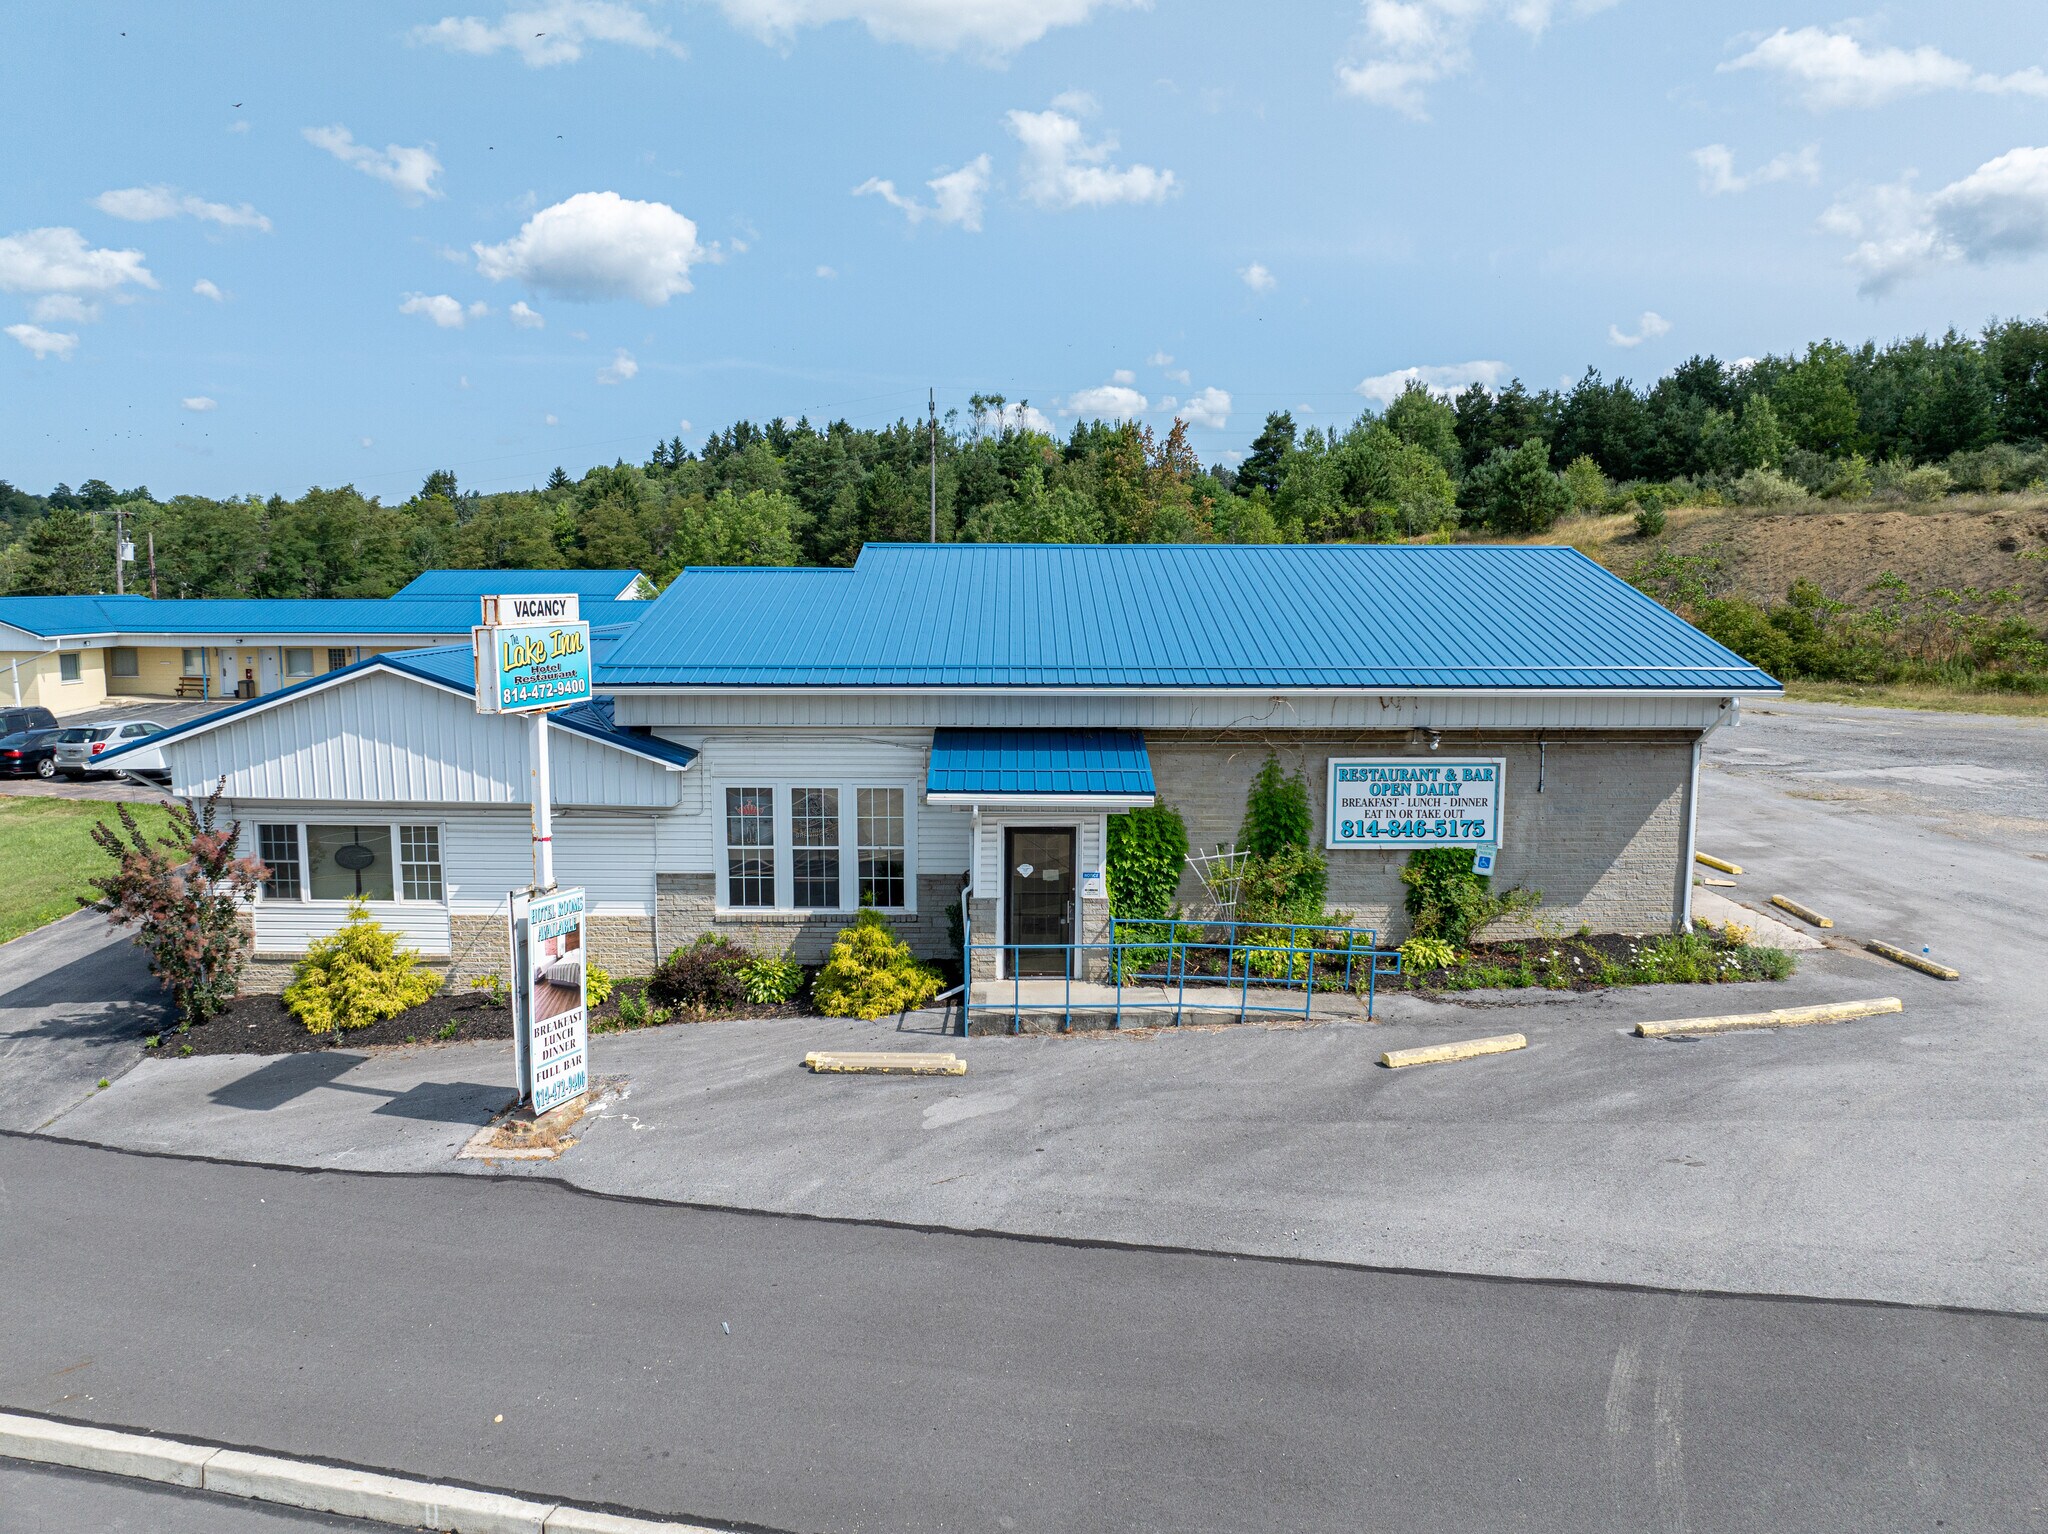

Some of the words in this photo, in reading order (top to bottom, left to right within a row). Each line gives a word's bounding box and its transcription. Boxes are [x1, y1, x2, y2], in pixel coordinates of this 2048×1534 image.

[514, 600, 566, 617] VACANCY
[510, 634, 519, 646] The
[503, 636, 547, 672] Lake
[549, 630, 583, 658] Inn
[514, 670, 577, 685] Restaurant
[531, 663, 561, 675] Hotel
[503, 679, 585, 704] 814-472-9400
[1338, 768, 1440, 782] RESTAURANT
[1444, 768, 1457, 782] &
[1462, 768, 1493, 782] BAR
[1369, 783, 1411, 796] OPEN
[1416, 783, 1462, 796] DAILY
[1341, 798, 1399, 807] BREAKFAST
[1408, 798, 1441, 807] LUNCH
[1450, 798, 1488, 807] DINNER
[1364, 809, 1383, 819] EAT
[1386, 809, 1396, 819] IN
[1399, 809, 1412, 819] OR
[1415, 809, 1441, 819] TAKE
[1443, 809, 1465, 819] OUT
[1341, 820, 1486, 837] 814-846-5175
[531, 904, 556, 924] HOTEL
[557, 897, 583, 917] ROOMS
[538, 916, 577, 942] AVAILABLE
[534, 1011, 583, 1038] BREAKFAST
[544, 1027, 574, 1047] LUNCH
[542, 1039, 576, 1061] DINNER
[536, 1064, 561, 1082] FULL
[564, 1055, 582, 1071] BAR
